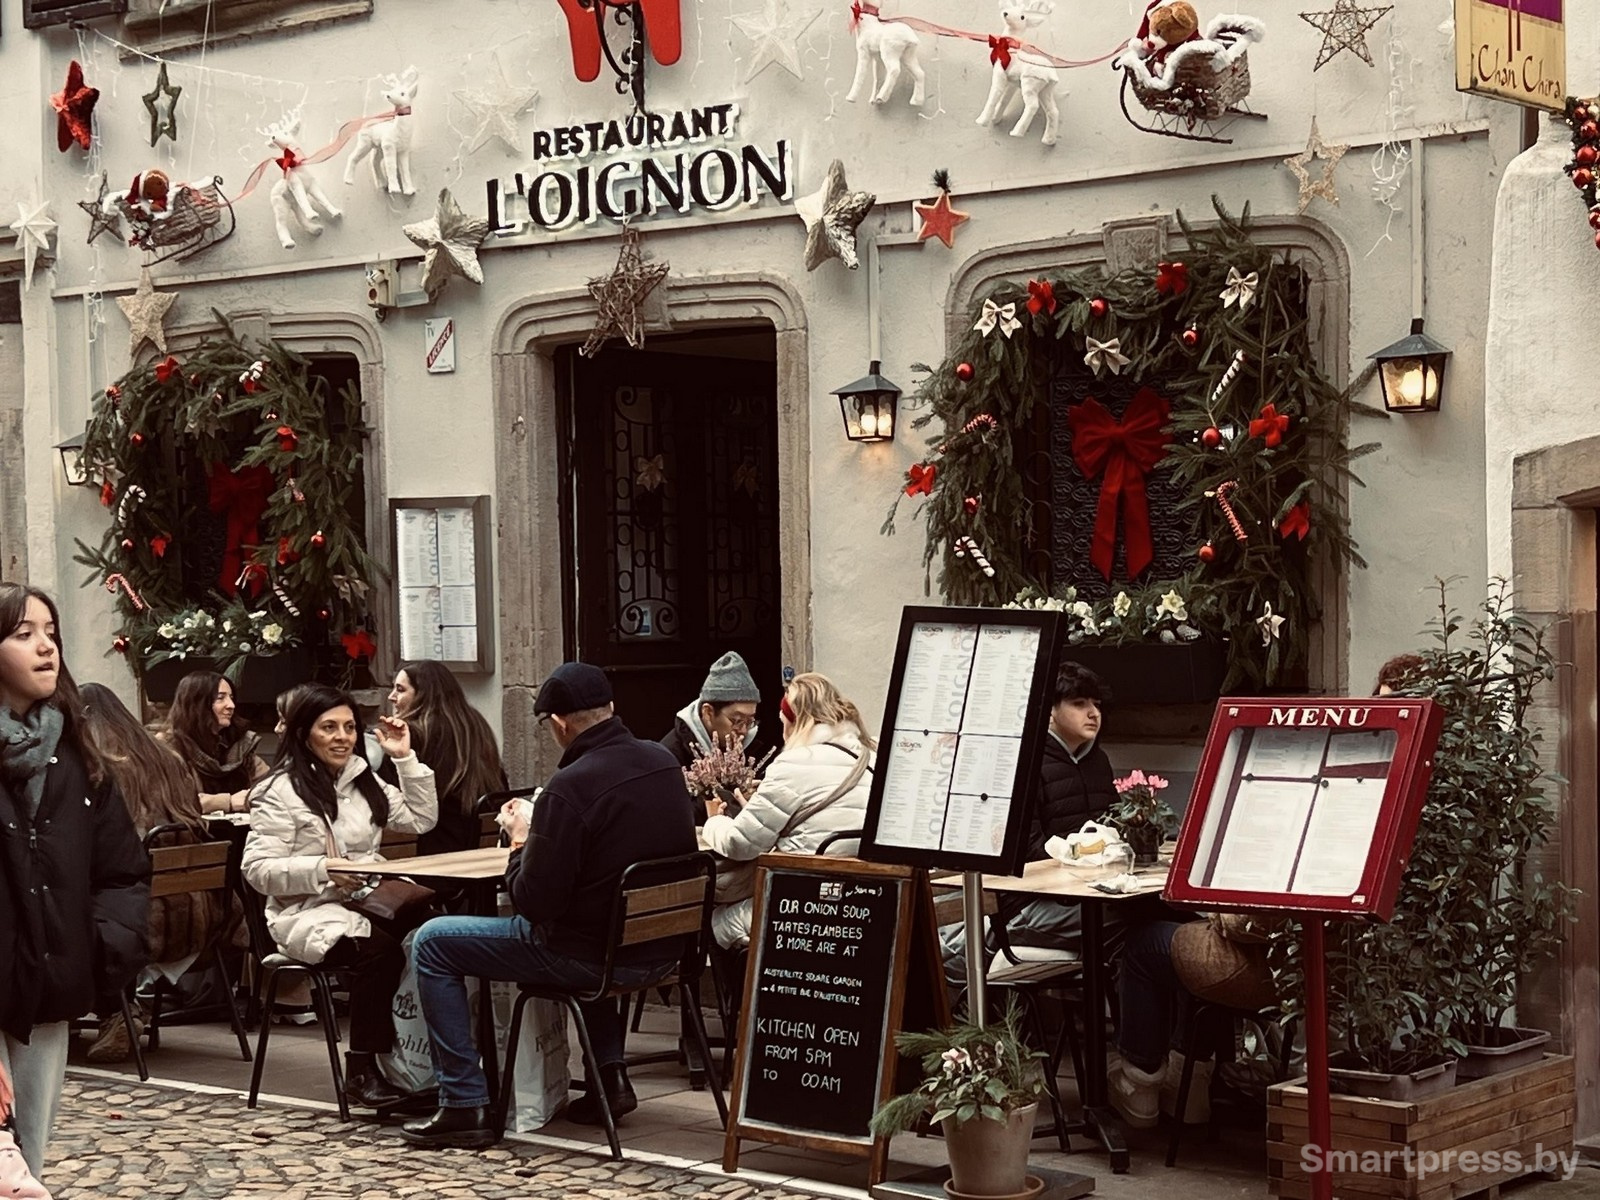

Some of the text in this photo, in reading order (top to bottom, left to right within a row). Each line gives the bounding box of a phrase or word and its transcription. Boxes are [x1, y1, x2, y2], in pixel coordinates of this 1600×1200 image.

[1478, 44, 1561, 99] Chan Chira
[533, 103, 734, 162] RESTAURANT
[486, 139, 791, 234] L'OIGNON
[1267, 707, 1372, 727] MENU
[779, 899, 799, 914] OUR
[804, 901, 838, 916] ONION
[772, 921, 863, 940] TARTES FLAMBEES
[775, 934, 859, 957] & MORE ARE AT
[763, 967, 863, 988] AUSTERLITZ SQUARE GARDEN
[777, 985, 797, 996] PETITE
[756, 1017, 860, 1047] KITCHEN OPEN
[765, 1044, 832, 1068] FROM 5PM
